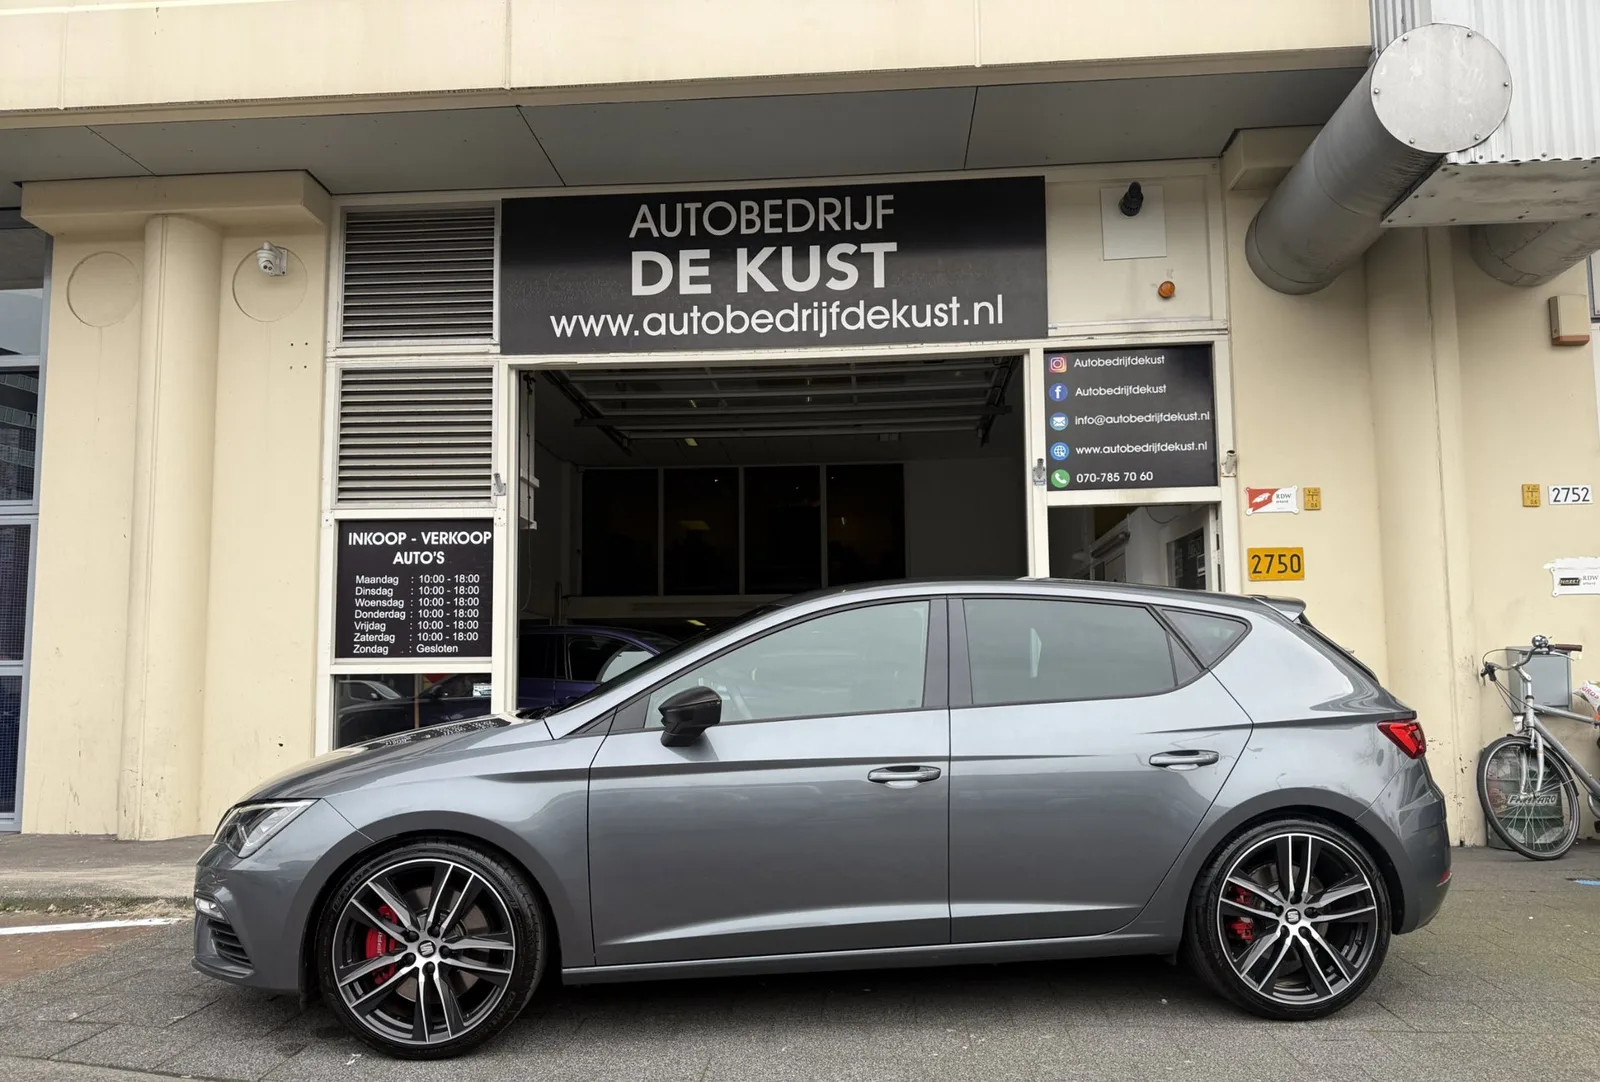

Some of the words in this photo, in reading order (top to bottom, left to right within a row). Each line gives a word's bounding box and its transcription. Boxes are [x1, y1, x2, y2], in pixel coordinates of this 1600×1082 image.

[629, 194, 895, 238] AUTOBEDRIJF
[631, 249, 712, 296] DE
[737, 241, 898, 293] KUST
[549, 294, 1003, 338] www.autobedrijfdekust.nl
[1074, 355, 1165, 368] Autobedrijfdekust
[1075, 384, 1167, 397] Autobedrijfdekust
[1075, 411, 1210, 425] info@autobedrijfdekust.nl
[1075, 441, 1208, 454] www.autobedrijfdekust.nl
[1076, 474, 1121, 483] 070-785
[1123, 472, 1138, 482] 70
[1139, 471, 1154, 481] 60
[1552, 487, 1590, 502] 2752
[349, 532, 407, 545] INKOOP
[421, 531, 492, 545] VERKOOP
[393, 551, 445, 565] AUTO'S
[1251, 554, 1301, 574] 2750
[356, 575, 399, 586] Maandag
[419, 575, 444, 583] 10:00
[454, 575, 479, 583] 18:00
[355, 587, 394, 597] Dinsdag
[419, 587, 444, 595] 10:00
[454, 587, 479, 595] 18:00
[355, 598, 404, 609] Woensdag
[418, 598, 443, 606] 10:00
[453, 598, 479, 606] 18:00
[354, 610, 406, 620] Donderdag
[418, 610, 443, 618] 10:00
[453, 610, 478, 618] 18:00
[354, 621, 386, 632] Vrijdag
[417, 621, 442, 629] 10:00
[452, 621, 478, 629] 18:00
[354, 633, 396, 643] Zaterdag
[417, 633, 442, 641] 10:00
[452, 633, 478, 641] 18:00
[353, 644, 389, 655] Zondag
[416, 644, 458, 653] Gesloten
